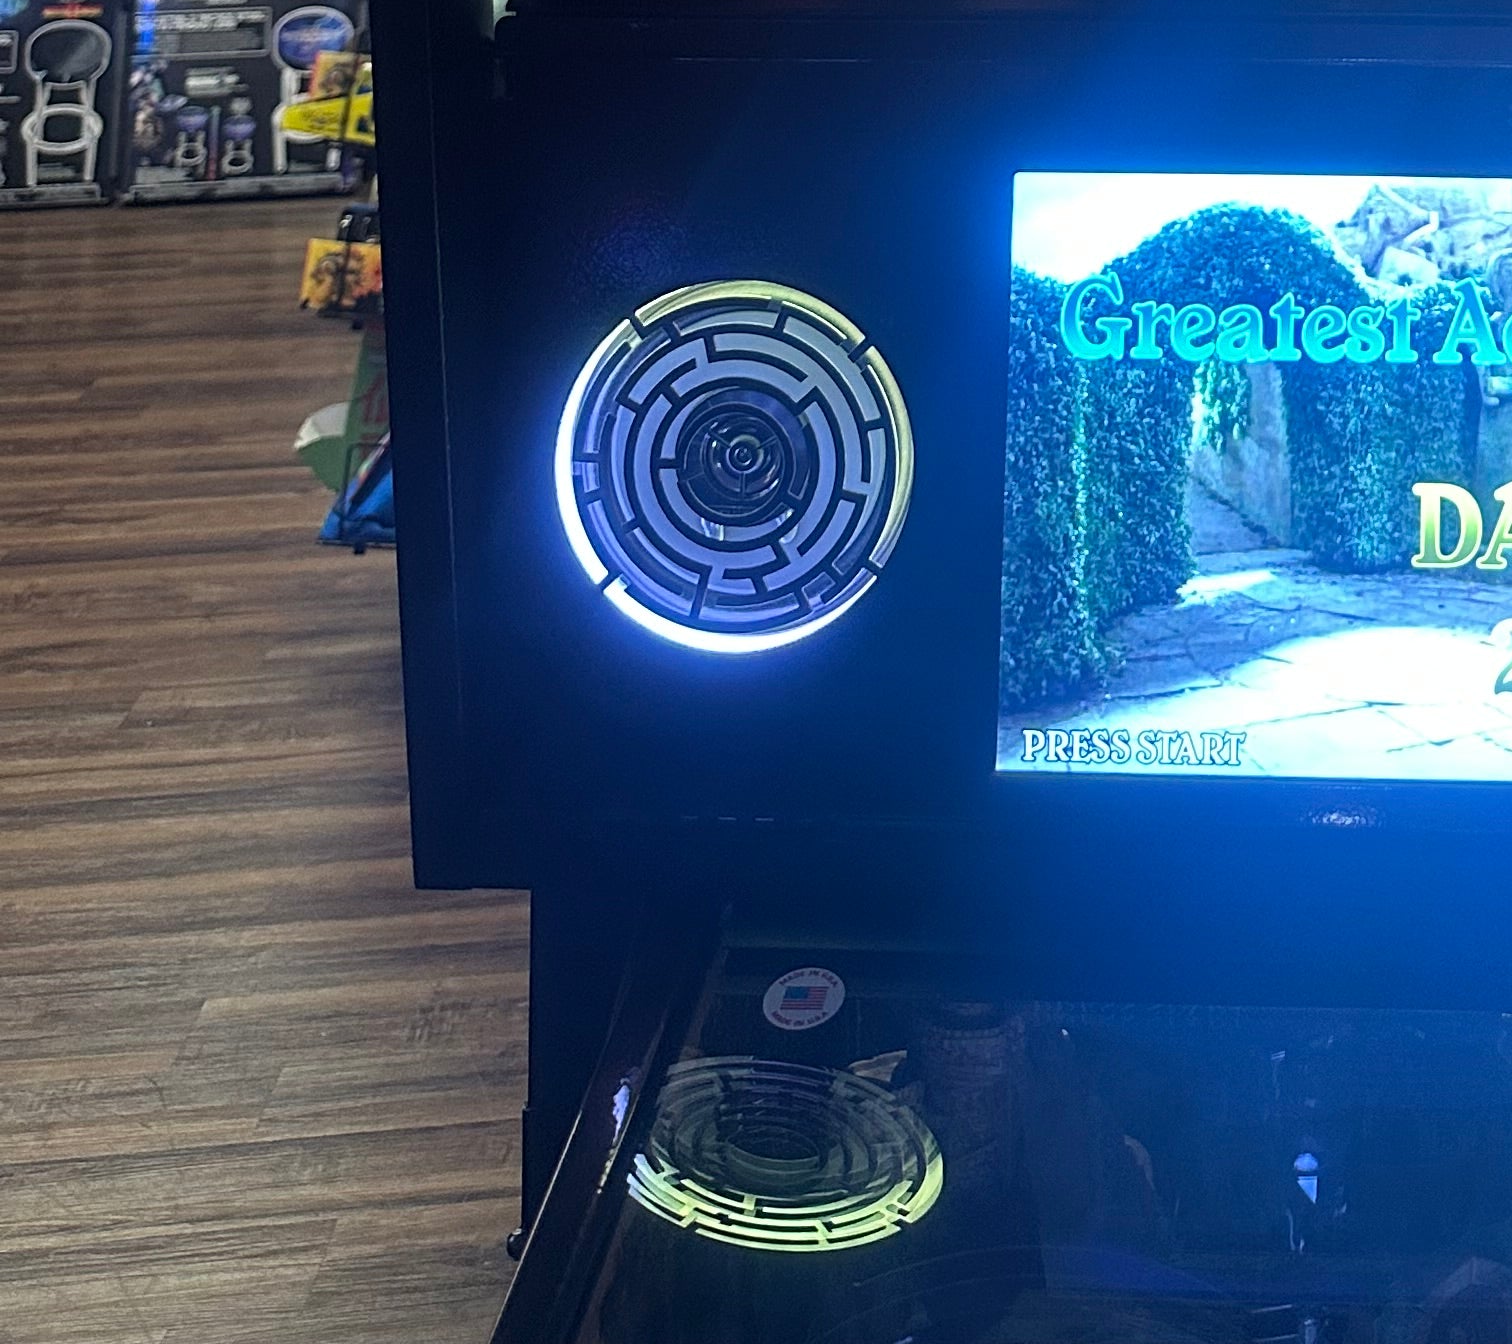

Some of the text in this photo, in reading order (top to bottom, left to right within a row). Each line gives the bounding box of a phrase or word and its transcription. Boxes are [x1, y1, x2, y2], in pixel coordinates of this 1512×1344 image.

[1060, 272, 1420, 364] Greatest
[1021, 729, 1247, 766] PRESS START
